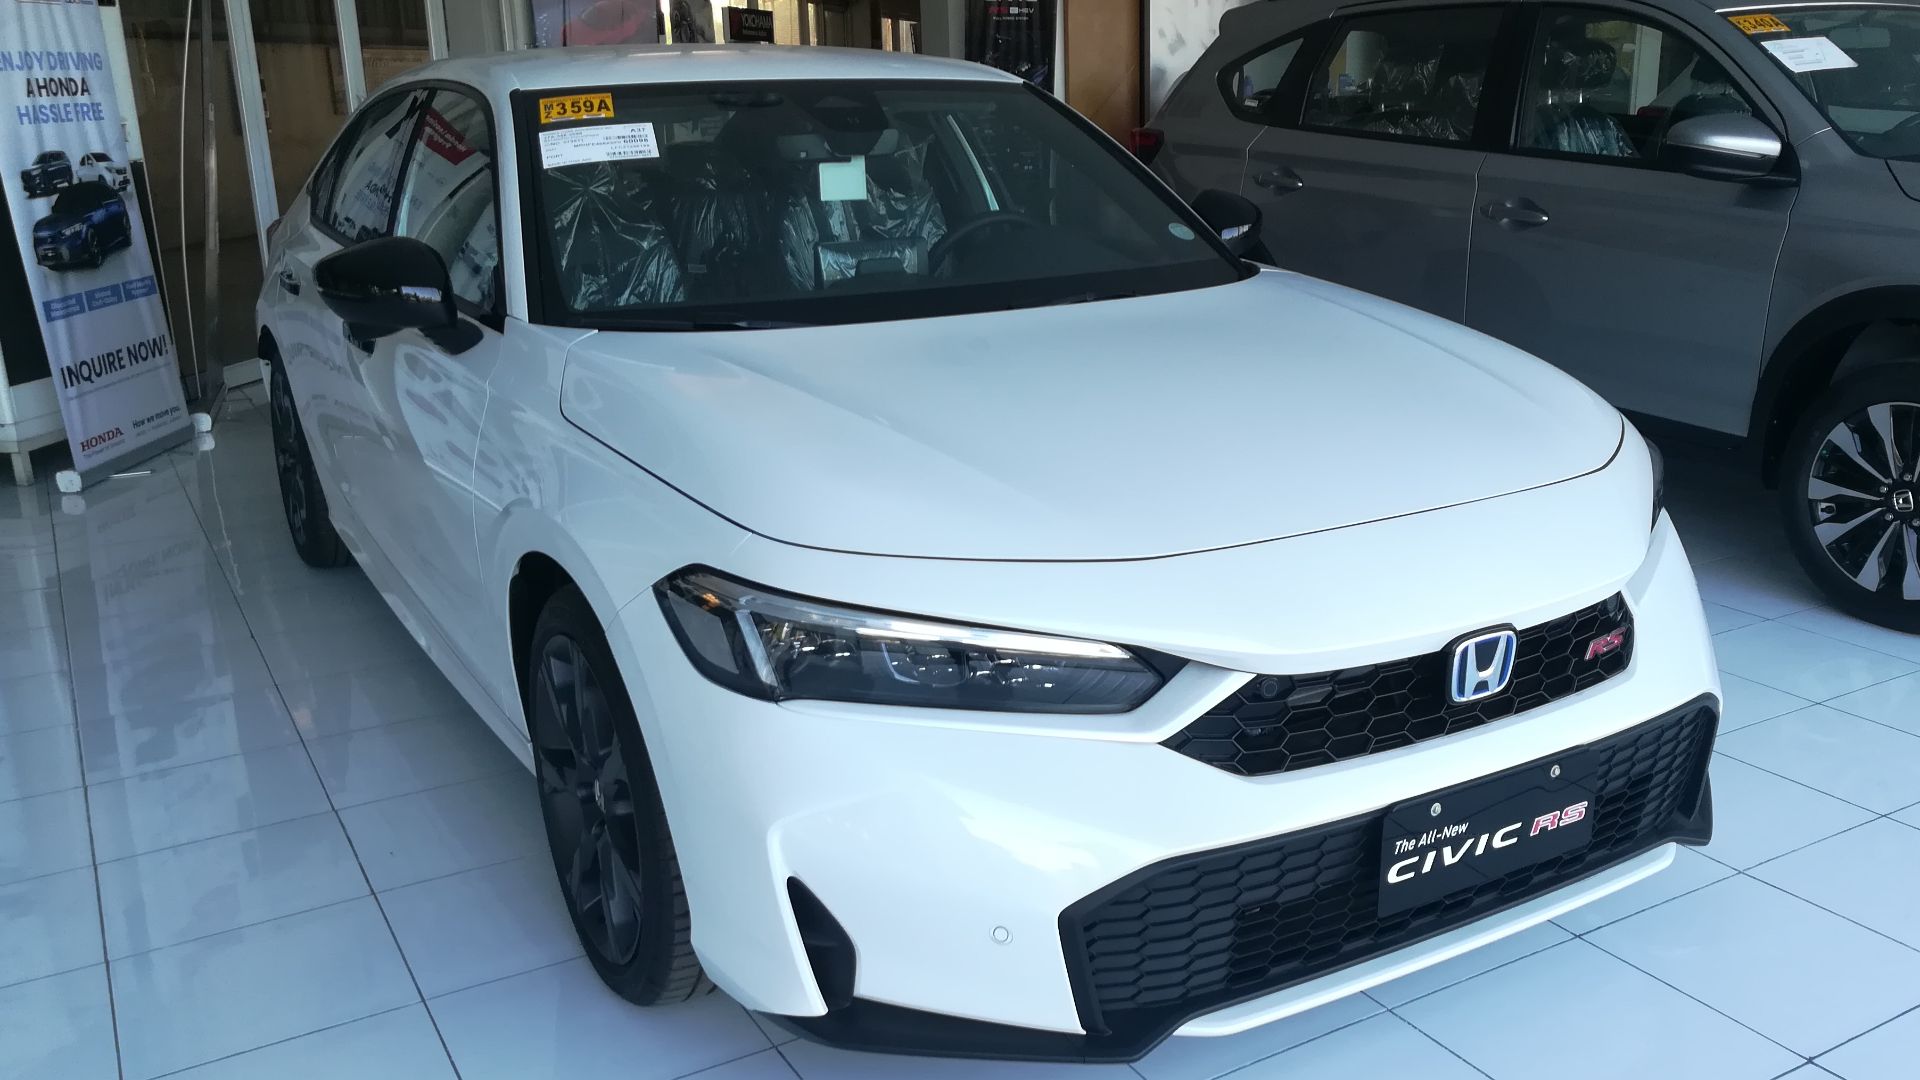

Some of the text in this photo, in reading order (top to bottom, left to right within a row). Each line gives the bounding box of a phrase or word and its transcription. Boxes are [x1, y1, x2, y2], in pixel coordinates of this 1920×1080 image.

[47, 51, 103, 71] DRIVING
[36, 77, 91, 97] HONDA
[17, 102, 105, 125] HASSLE FREE
[556, 100, 611, 115] 359A
[60, 334, 169, 390] INQUIRE NOW!
[80, 427, 124, 452] HONDA
[1584, 626, 1627, 661] RS
[1387, 800, 1588, 884] CIVIC RS
[1394, 821, 1469, 855] The All-New
